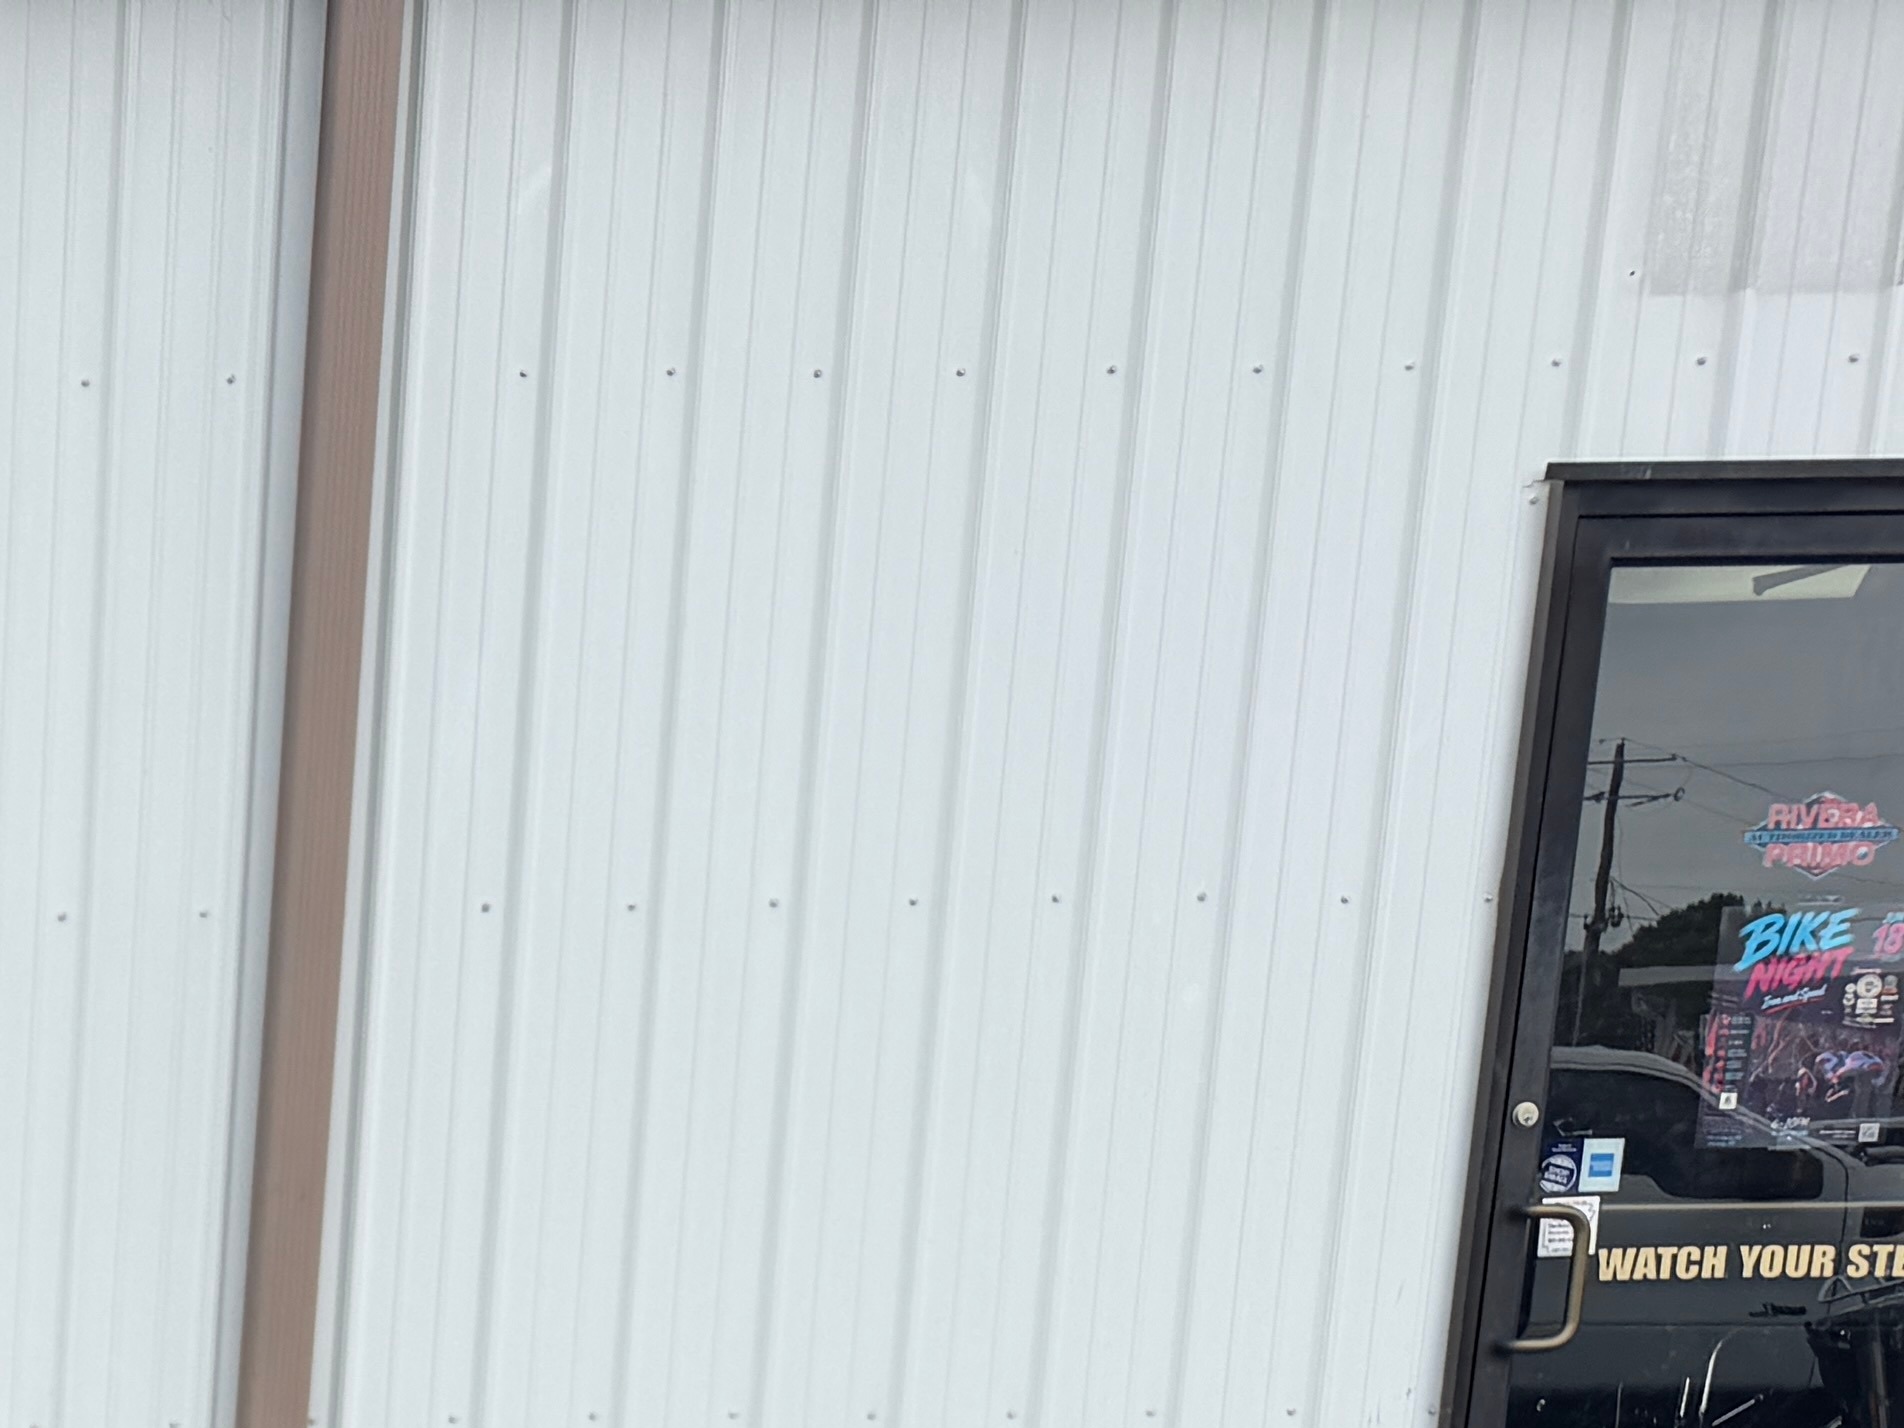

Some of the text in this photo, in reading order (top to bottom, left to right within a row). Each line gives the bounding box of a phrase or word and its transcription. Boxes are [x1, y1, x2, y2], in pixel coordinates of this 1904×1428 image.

[1767, 802, 1879, 830] RIVERA
[1733, 908, 1863, 972] BIKE
[1744, 946, 1856, 1000] NIGHT
[1598, 1245, 1728, 1281] WATCH
[1740, 1244, 1836, 1279] YOUR
